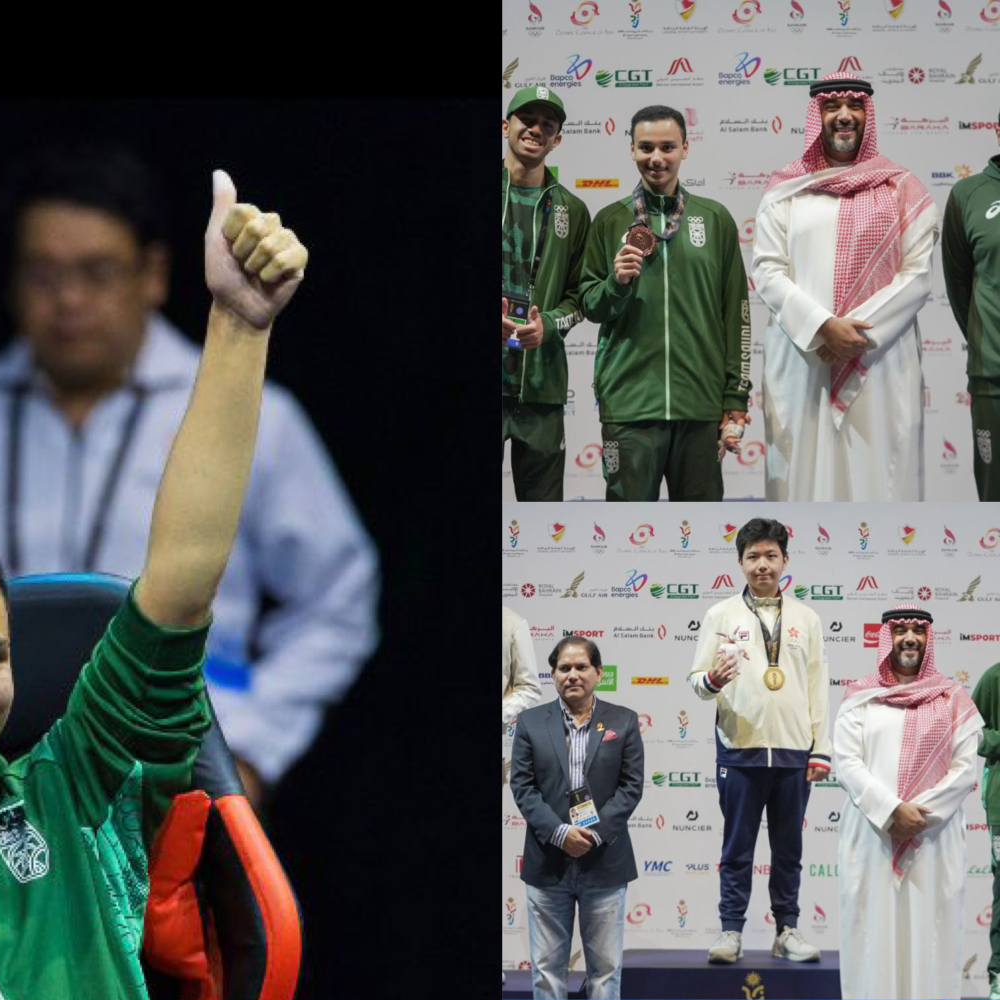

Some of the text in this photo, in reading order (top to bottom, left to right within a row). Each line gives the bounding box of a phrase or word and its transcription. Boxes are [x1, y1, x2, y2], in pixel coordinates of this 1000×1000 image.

[550, 74, 574, 82] Bapco
[614, 70, 653, 82] CGT
[718, 72, 742, 80] Bapco
[784, 68, 822, 80] CGT
[740, 324, 751, 362] SAUDI
[611, 586, 632, 594] Bapco
[666, 584, 700, 594] CGT
[811, 584, 844, 596] CGT
[562, 630, 604, 638] iMSPORT
[959, 633, 1000, 642] iMSPORT
[669, 772, 702, 782] CGT
[672, 824, 712, 832] NUNCIER
[644, 860, 673, 872] YMC
